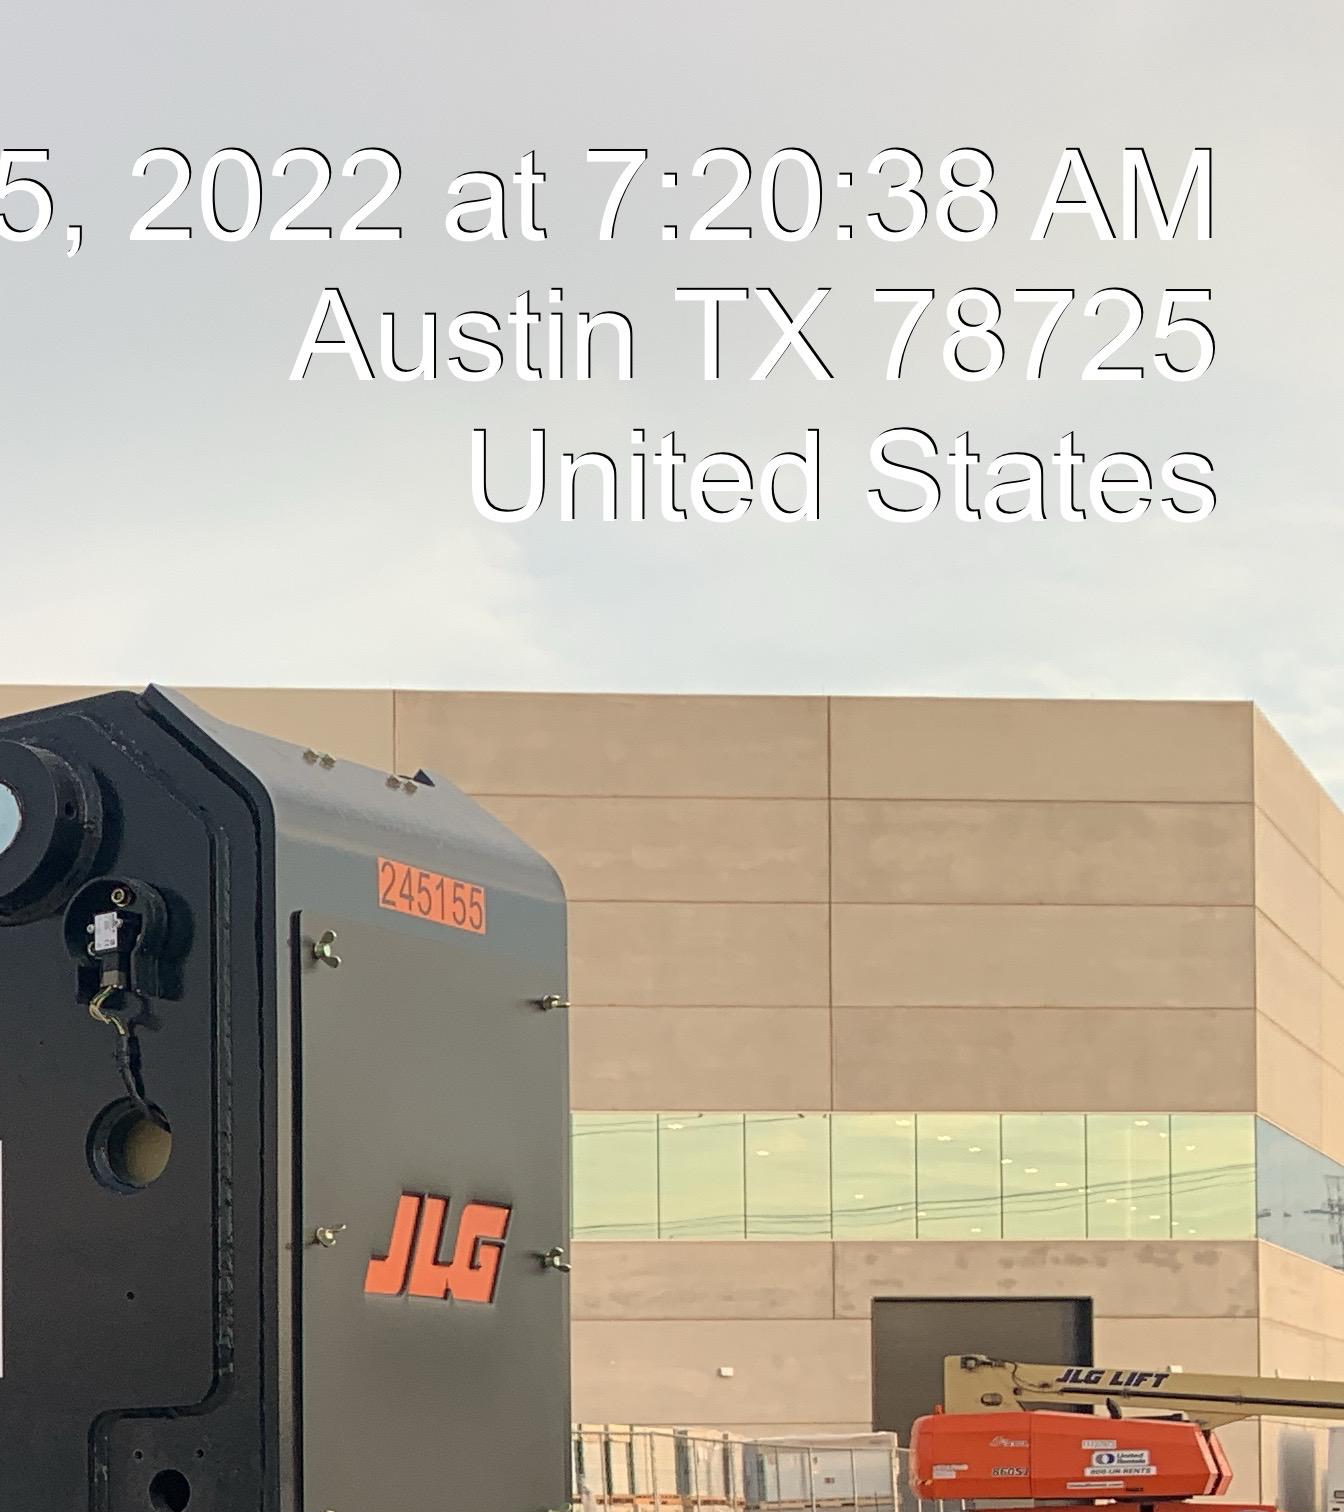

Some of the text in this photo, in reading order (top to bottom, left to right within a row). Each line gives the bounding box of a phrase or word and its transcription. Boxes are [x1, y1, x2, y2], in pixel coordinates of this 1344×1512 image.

[379, 860, 484, 931] 245155
[364, 1194, 510, 1303] JLG
[1055, 1368, 1170, 1388] JLG LIFT
